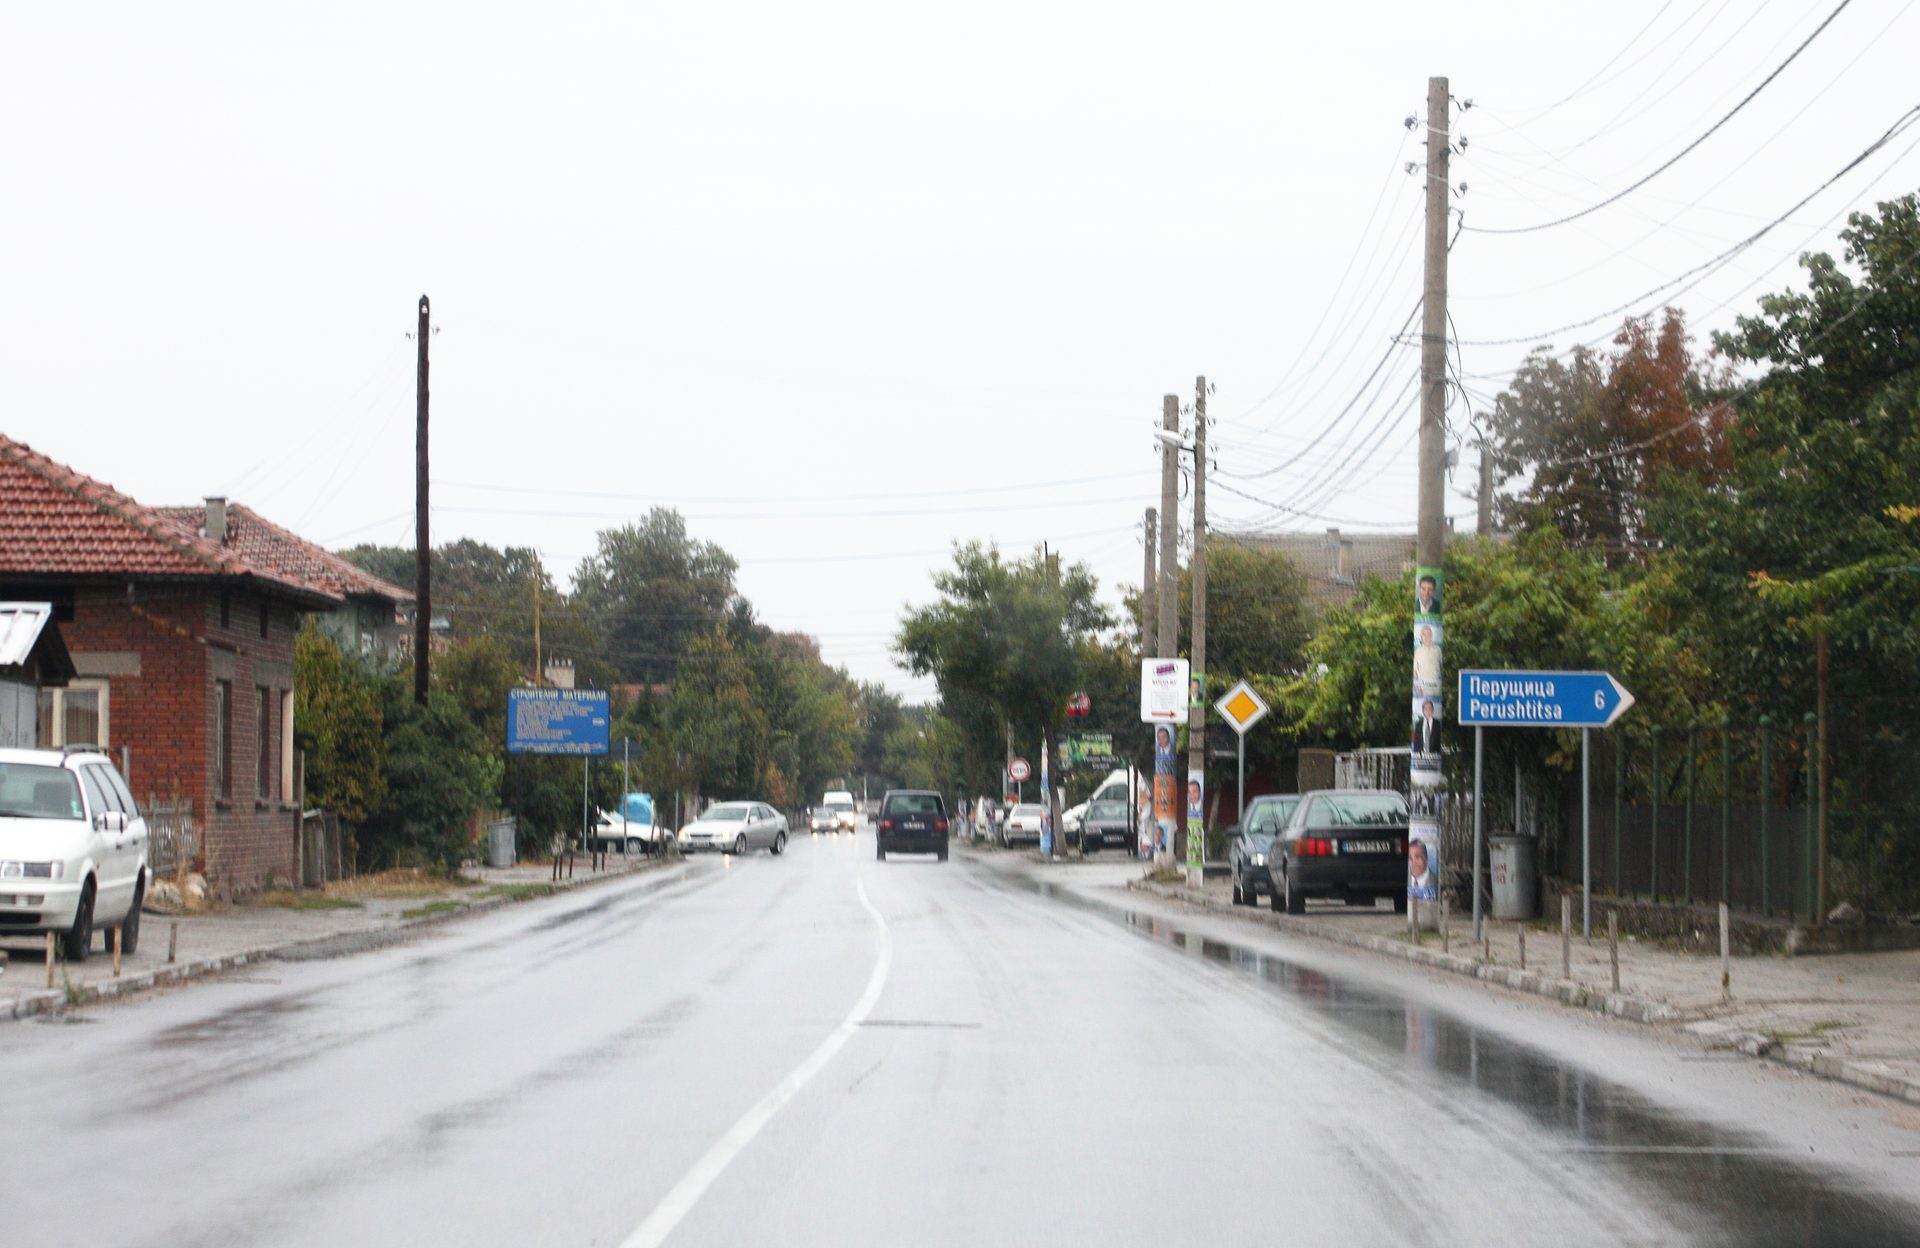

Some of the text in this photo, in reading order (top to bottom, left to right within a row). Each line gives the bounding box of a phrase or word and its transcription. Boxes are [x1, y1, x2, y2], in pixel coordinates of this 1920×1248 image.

[1470, 676, 1555, 700] Перущица
[1470, 699, 1563, 720] Perushtitsa
[1594, 690, 1606, 710] 6
